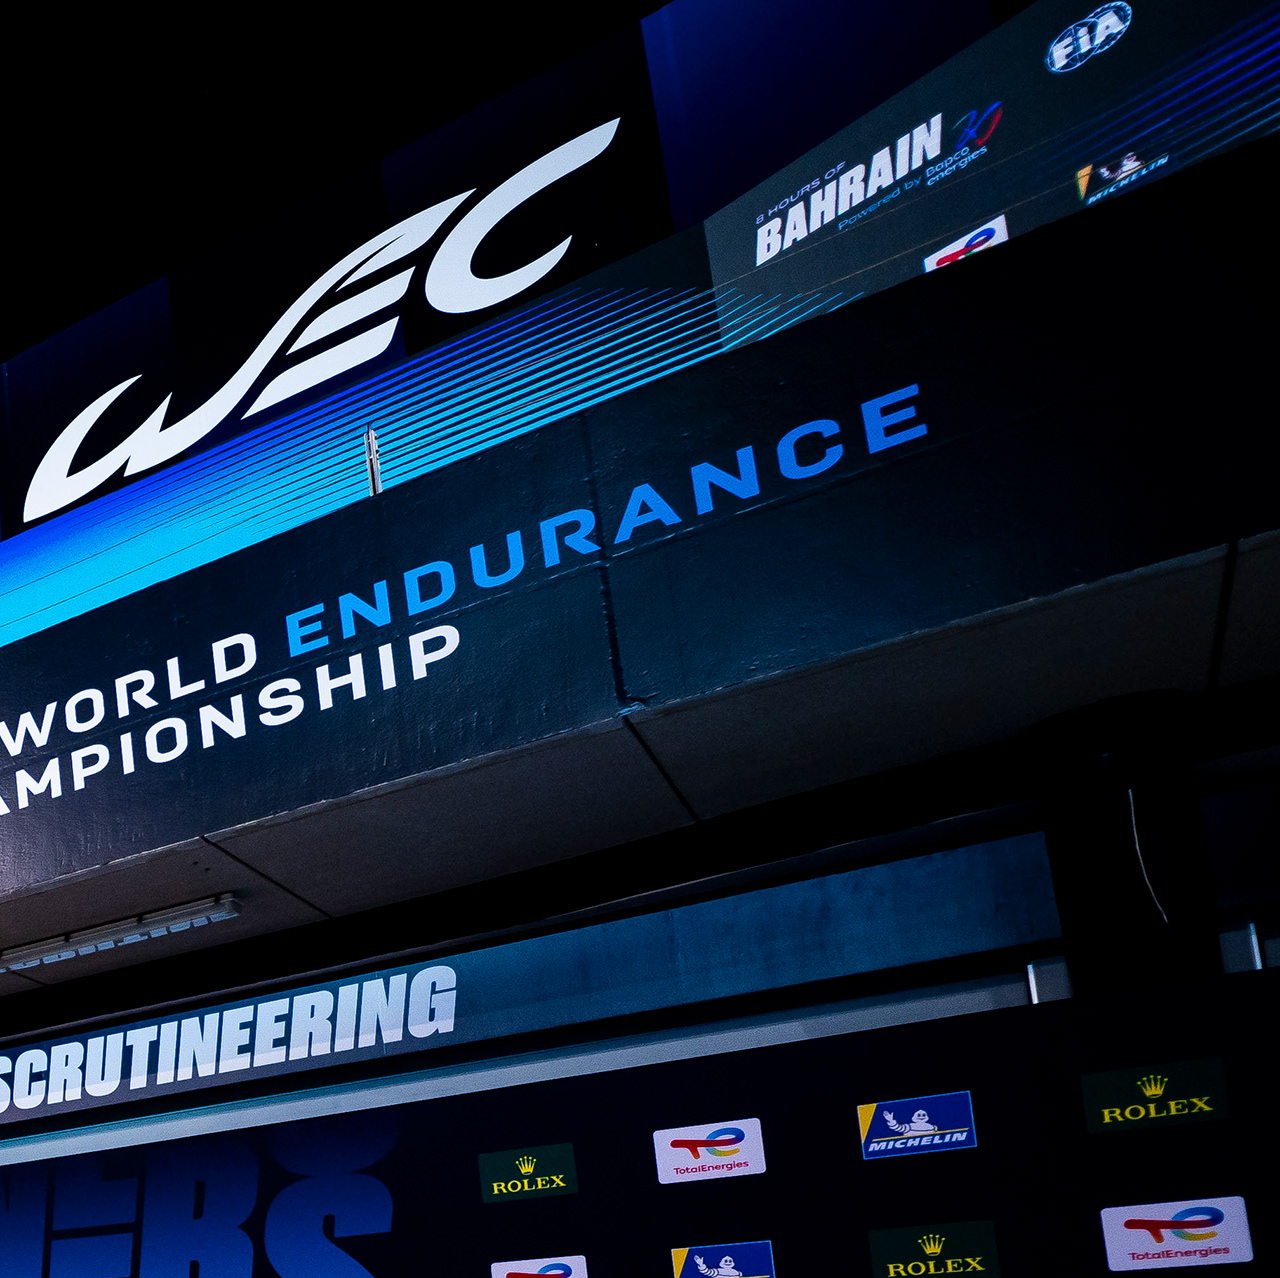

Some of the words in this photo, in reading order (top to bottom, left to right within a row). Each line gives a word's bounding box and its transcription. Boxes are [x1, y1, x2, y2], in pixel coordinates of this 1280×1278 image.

[1051, 10, 1126, 70] FIA
[925, 146, 969, 178] Bapco
[926, 145, 988, 187] energies
[1086, 154, 1170, 206] MICHELIN
[755, 214, 765, 225] 8
[768, 178, 821, 217] HOURS
[824, 161, 846, 180] OF
[756, 112, 942, 267] BAHRAIN
[838, 188, 901, 231] Powered
[904, 177, 922, 191] by
[23, 117, 621, 523] WEC
[286, 383, 928, 658] ENDURANCE
[1101, 1096, 1214, 1125] ROLEX
[868, 1131, 968, 1153] MICHELIN
[492, 1173, 567, 1195] ROLEX
[673, 1158, 750, 1176] TotalEnergies
[887, 1256, 986, 1278] ROLEX
[1128, 1244, 1231, 1263] TotalEnergies
